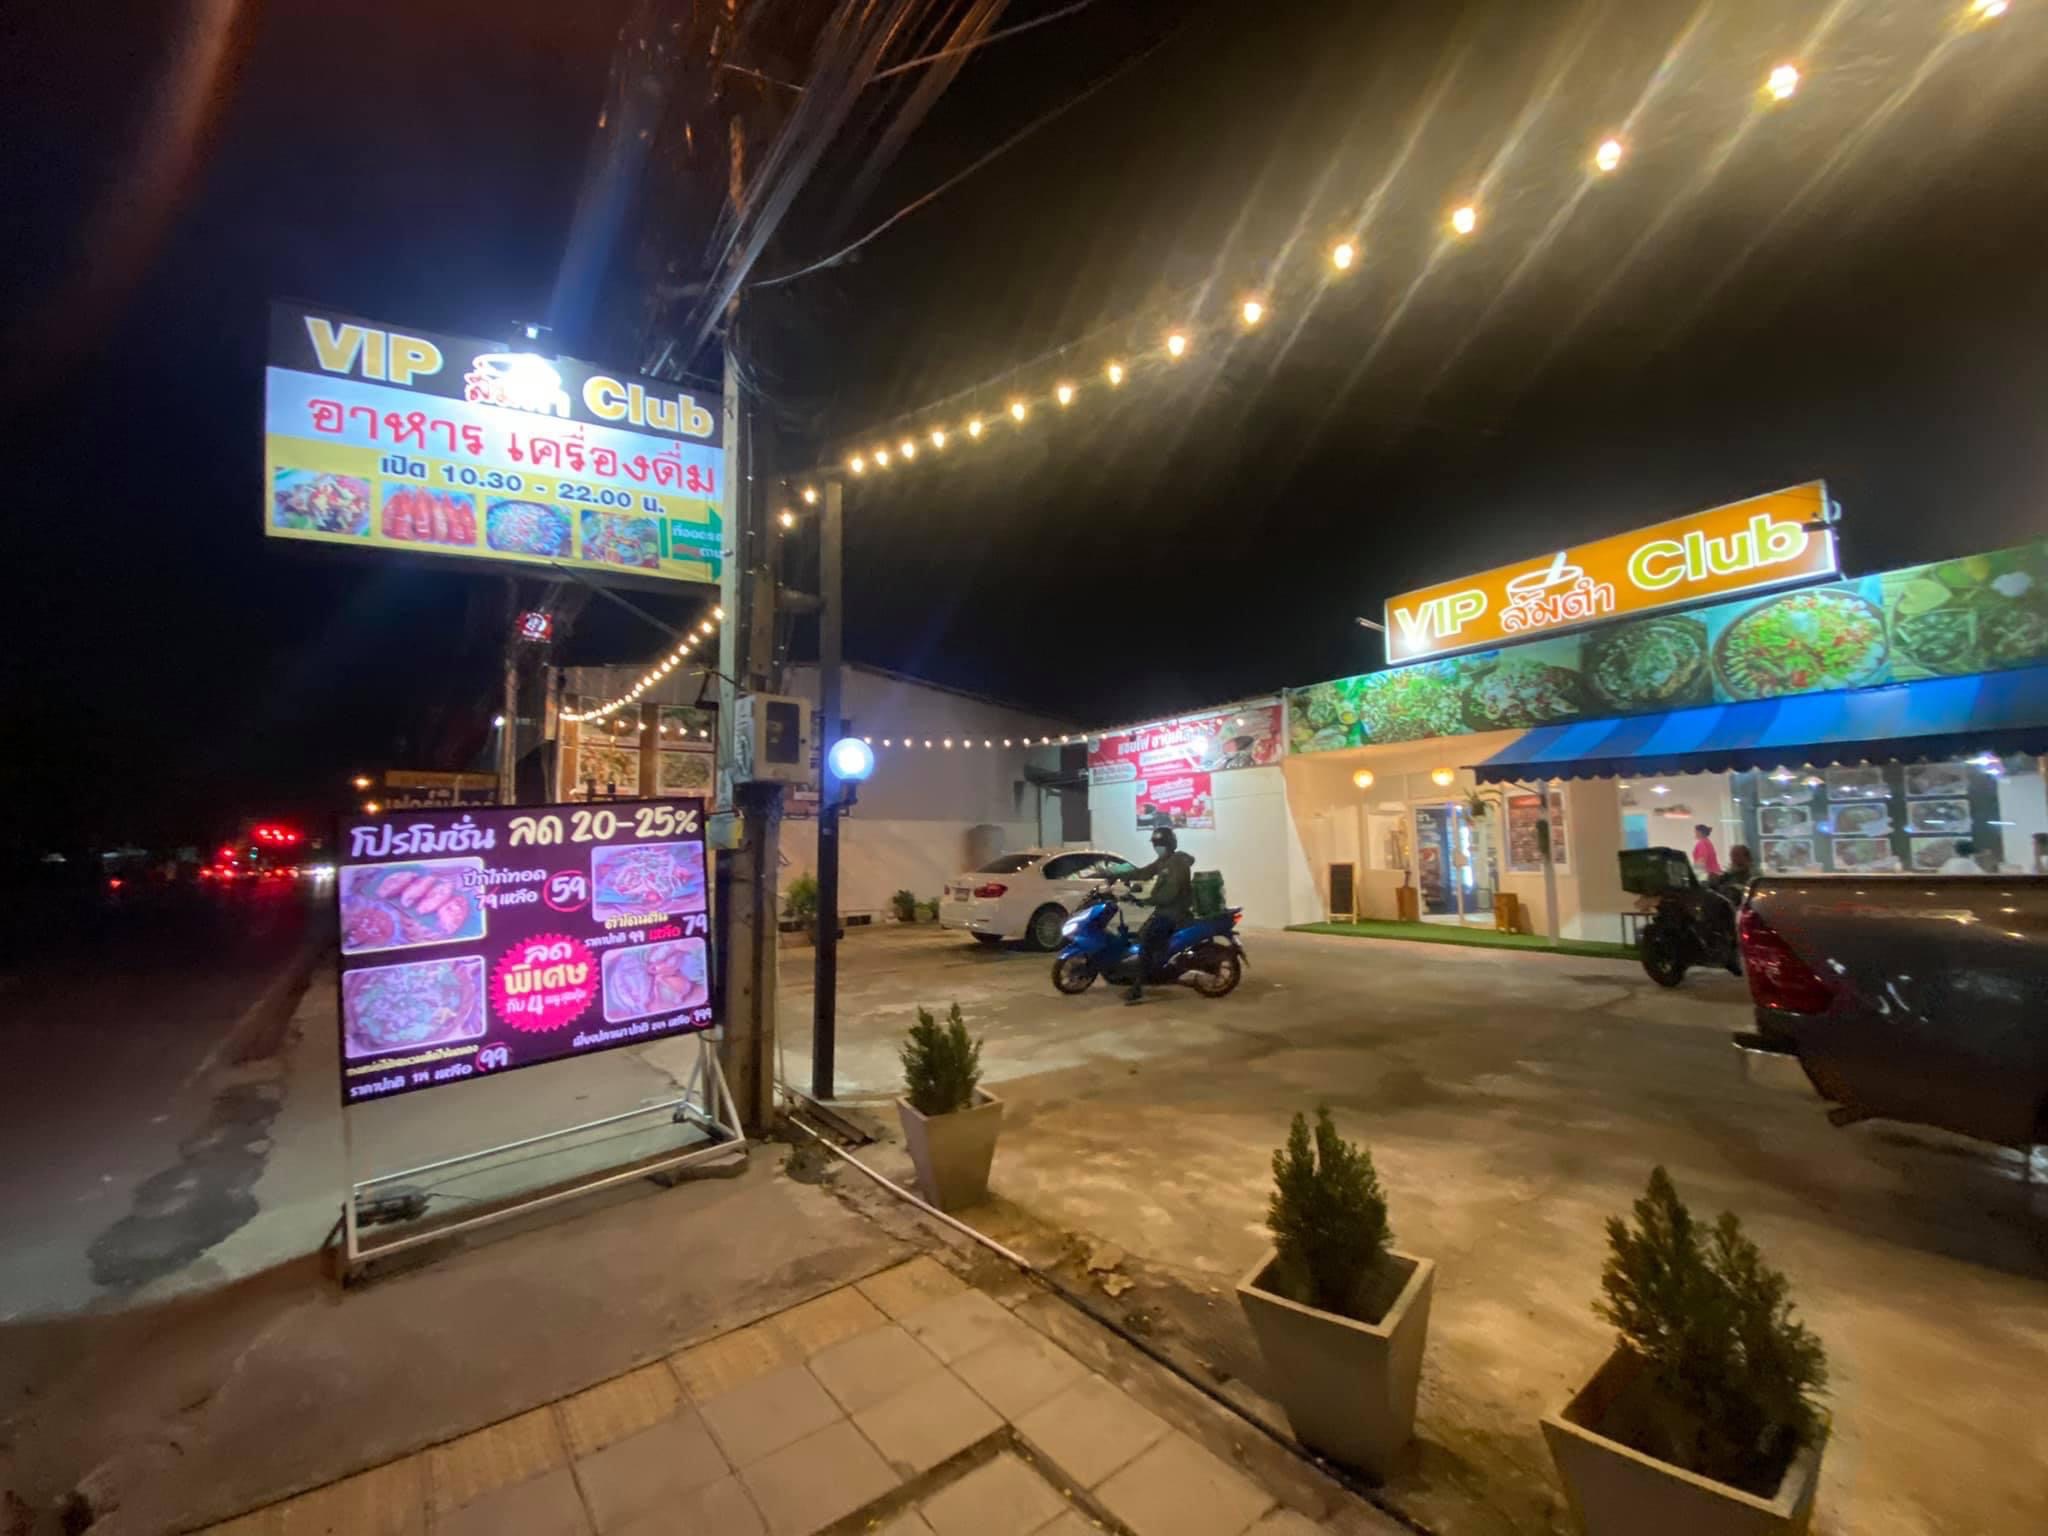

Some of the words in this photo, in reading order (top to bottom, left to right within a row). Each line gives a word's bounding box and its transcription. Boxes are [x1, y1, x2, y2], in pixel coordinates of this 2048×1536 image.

[303, 315, 443, 385] VIP
[583, 377, 714, 438] Club
[308, 398, 483, 455] อาหาร
[508, 425, 715, 494] เครื่องดื่ม
[381, 454, 426, 479] เปิด
[443, 465, 522, 492] 10.30
[559, 482, 632, 507] 22.00
[1394, 590, 1487, 649] VIP
[1498, 577, 1615, 633] ส้มตำ
[1628, 514, 1808, 591] Club
[350, 814, 496, 857] โปรโมชั่น
[508, 815, 563, 847] ลด
[571, 806, 698, 842] 20-25%
[500, 888, 538, 905] เหลือ
[551, 876, 586, 903] 59
[682, 913, 707, 936] 79
[524, 942, 572, 964] ลด
[504, 962, 589, 995] พิเศษ
[527, 995, 544, 1015] 4
[479, 1045, 509, 1069] 99
